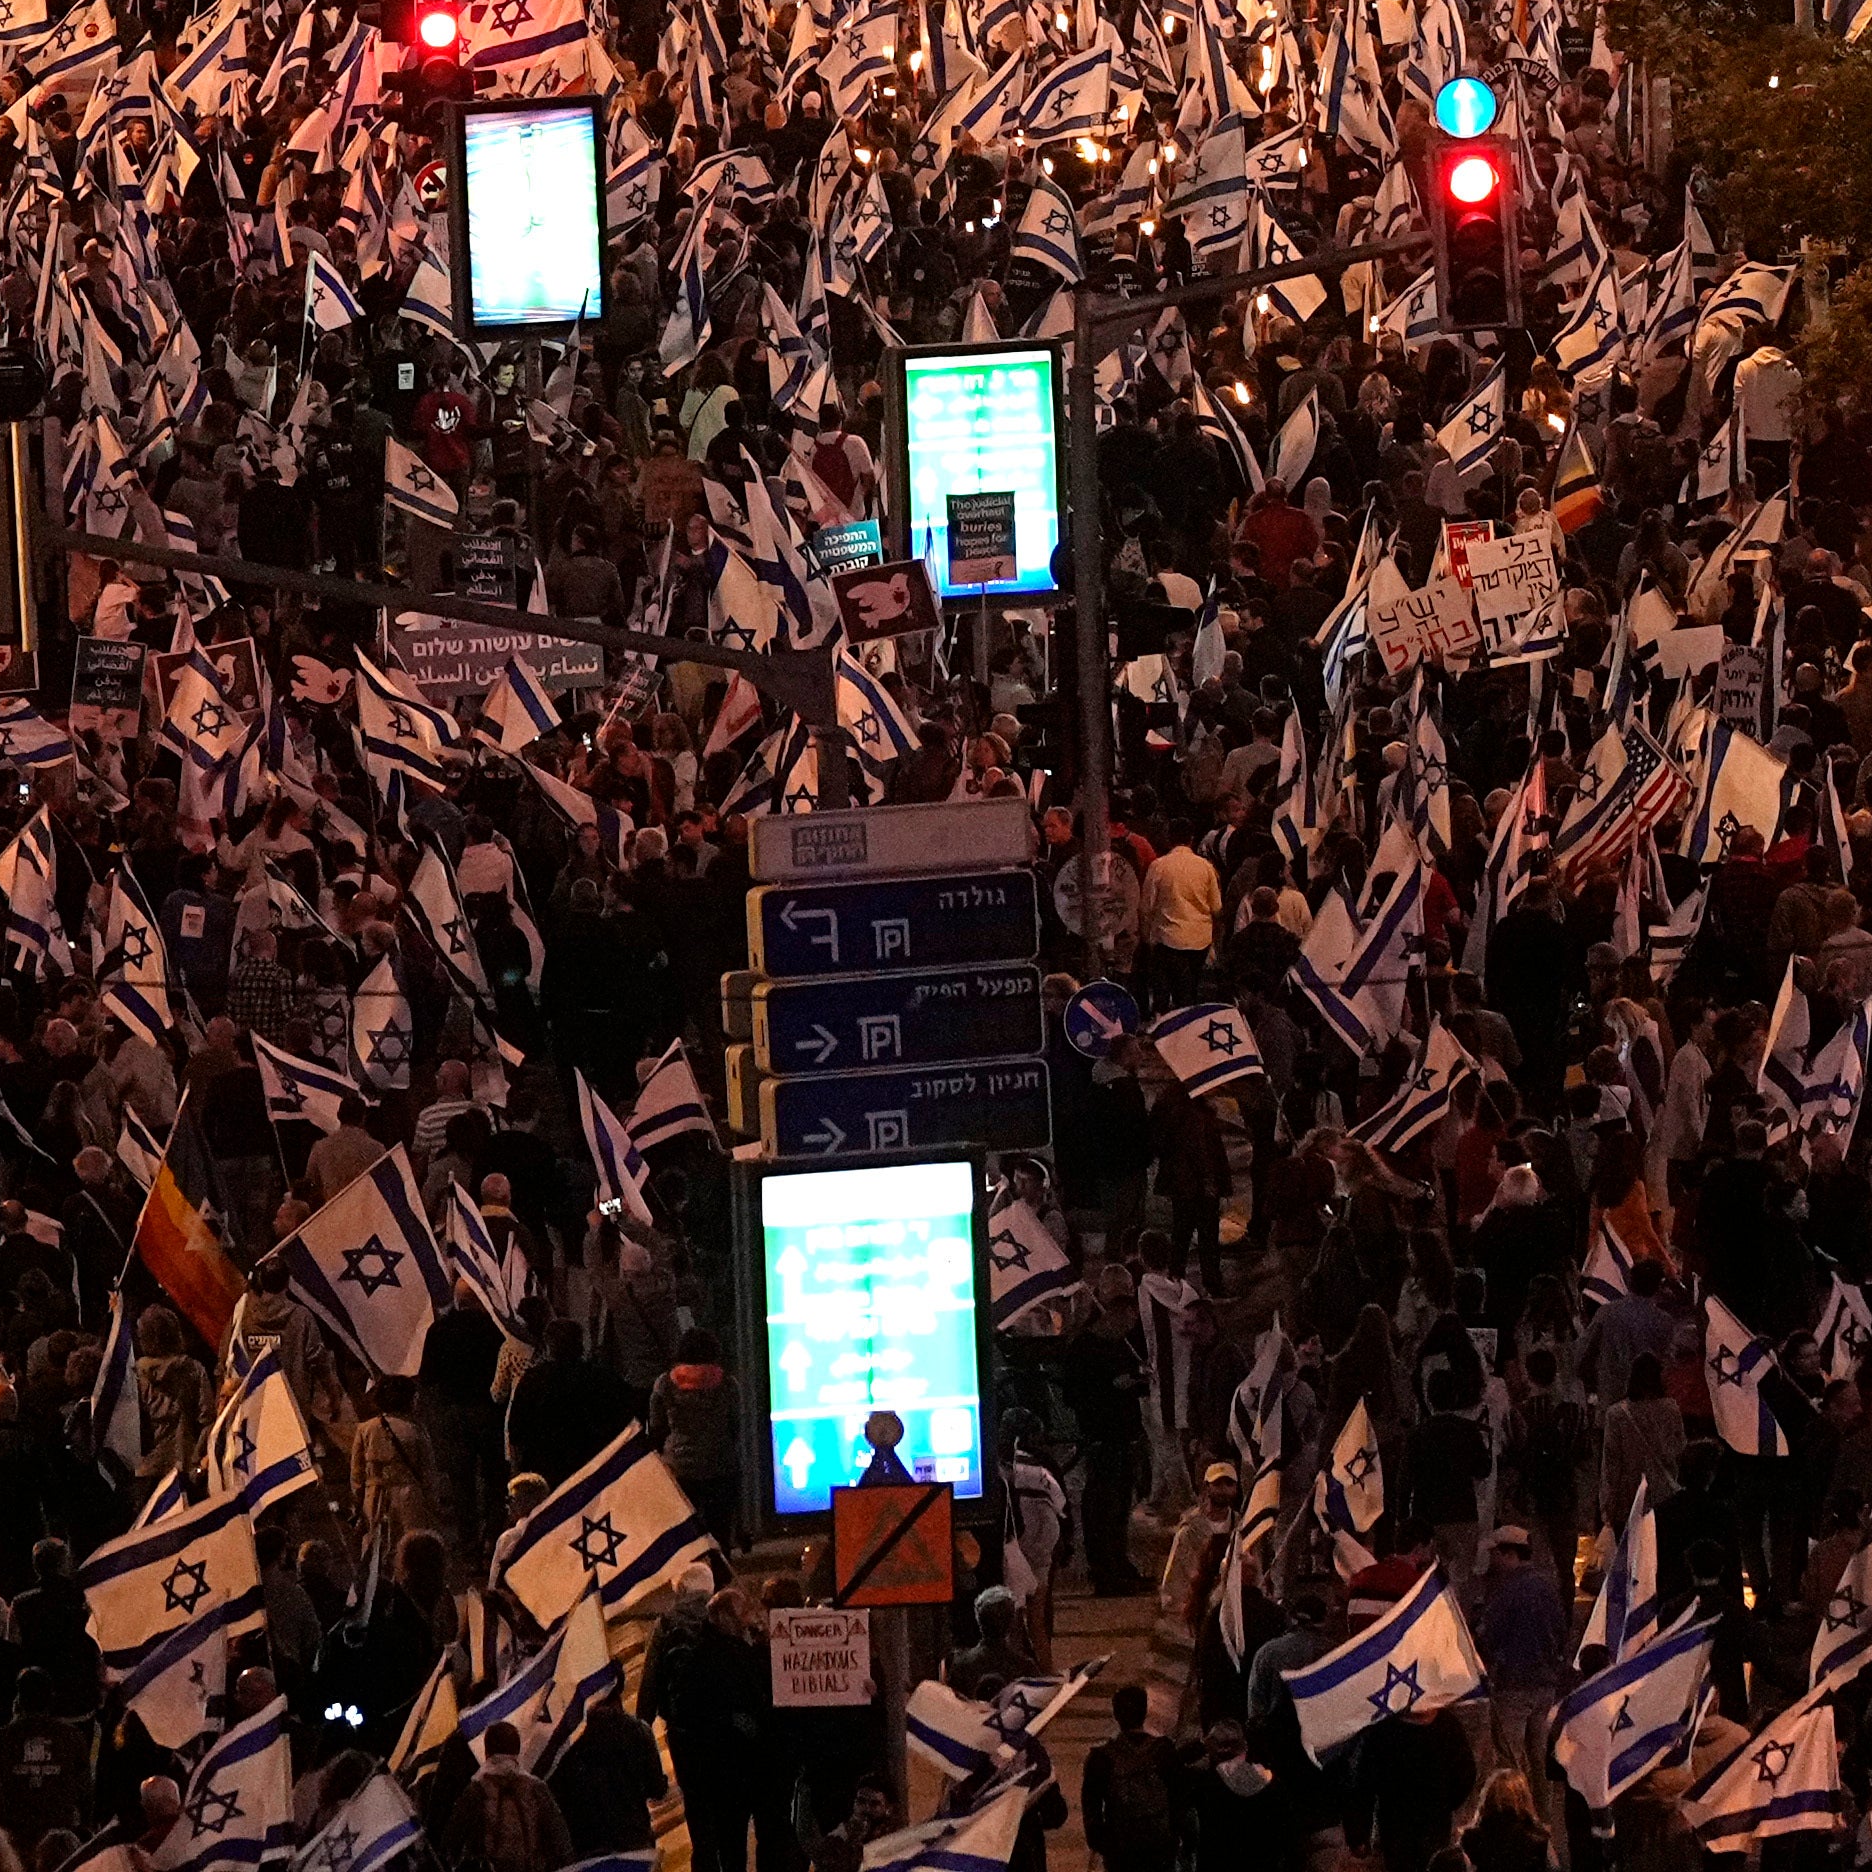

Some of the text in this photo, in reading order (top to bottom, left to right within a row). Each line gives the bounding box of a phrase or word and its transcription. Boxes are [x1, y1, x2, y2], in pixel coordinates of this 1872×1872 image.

[960, 521, 1003, 534] buries
[412, 637, 463, 657] שלום
[938, 885, 1006, 910] גולדה
[910, 1071, 1039, 1100] חניון לסקוב
